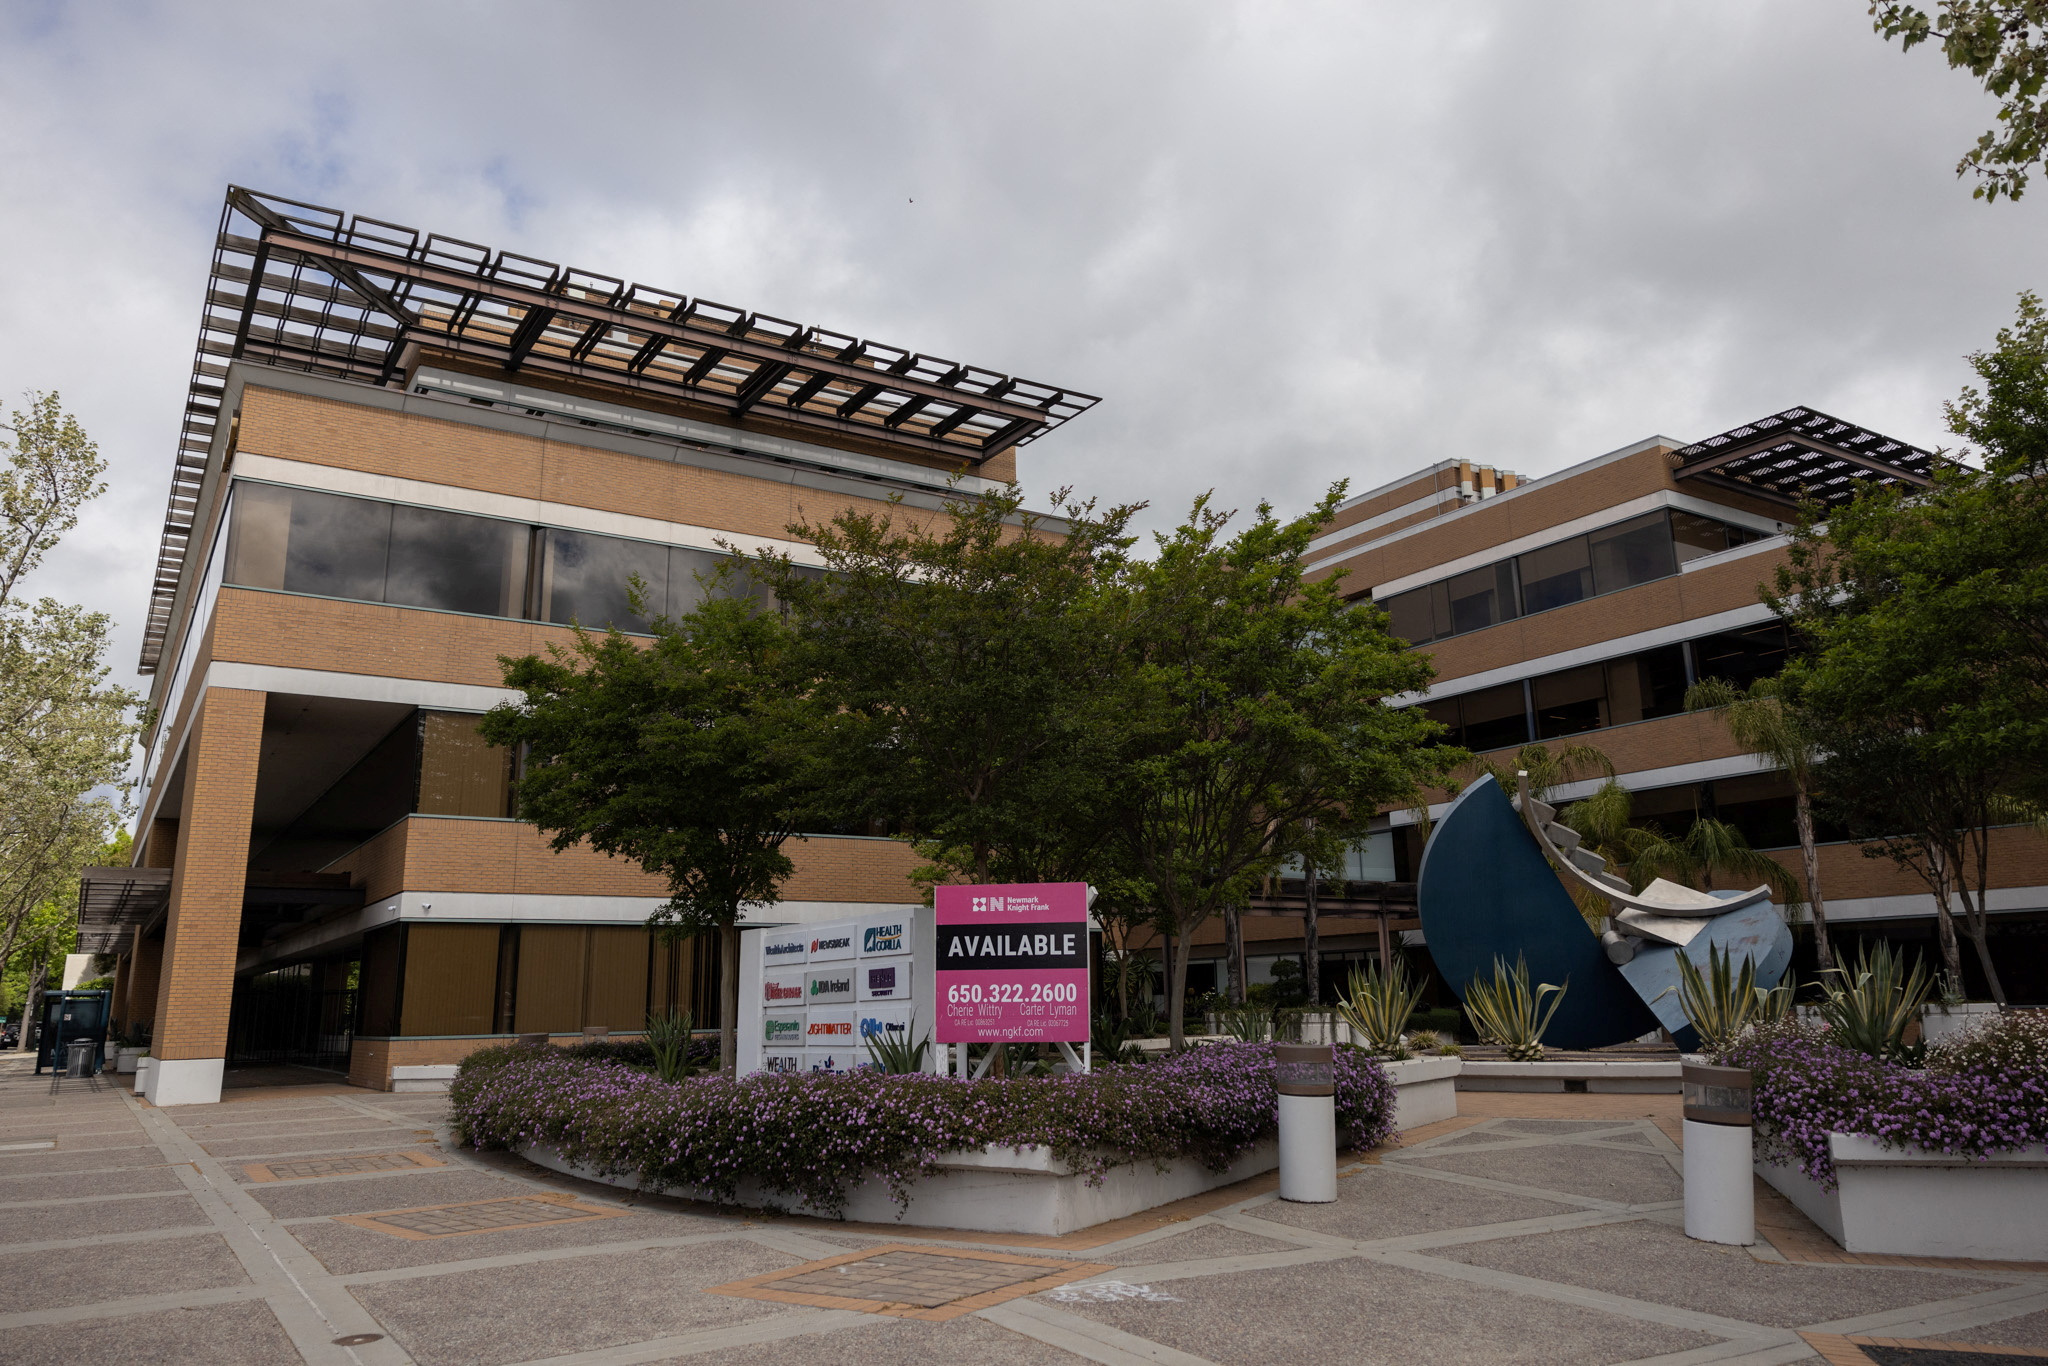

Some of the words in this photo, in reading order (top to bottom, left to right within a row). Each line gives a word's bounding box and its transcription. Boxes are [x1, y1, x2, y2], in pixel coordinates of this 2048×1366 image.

[1007, 896, 1039, 904] Newmark
[1007, 904, 1030, 913] Knight
[1030, 903, 1050, 911] Frank
[876, 924, 902, 937] HEALTH
[876, 939, 902, 952] GORILLA
[948, 934, 1076, 957] AVAILABLE
[818, 980, 829, 993] IDA
[830, 978, 850, 993] Ireland
[948, 983, 1077, 1003] 650.322.2600
[947, 1003, 974, 1017] Cherie
[978, 1003, 1003, 1019] Wittry
[1019, 1003, 1046, 1016] Carter
[1049, 1003, 1077, 1019] Lyman
[774, 1020, 800, 1034] Esperanto
[977, 1026, 1044, 1039] www.ngkf.com
[767, 1056, 797, 1073] WEALTH
